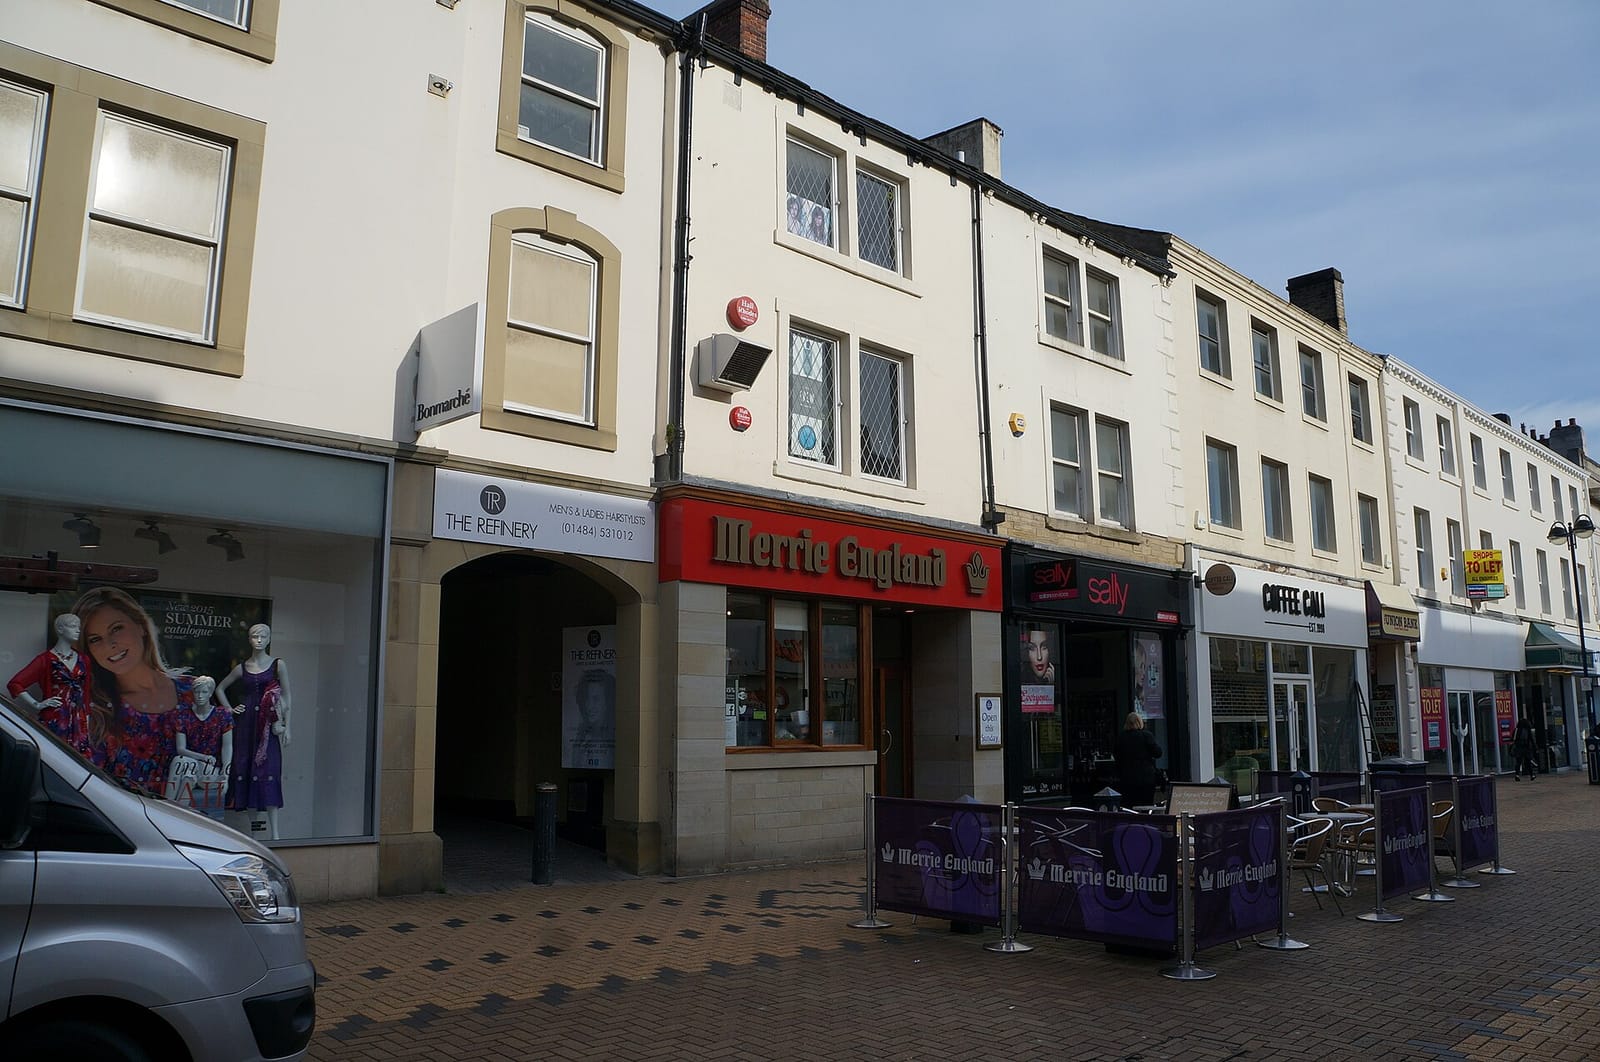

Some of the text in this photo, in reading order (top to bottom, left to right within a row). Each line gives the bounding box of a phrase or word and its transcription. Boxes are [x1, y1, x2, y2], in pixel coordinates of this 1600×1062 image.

[417, 388, 470, 421] Bonmarché
[485, 490, 501, 511] TR
[549, 504, 646, 526] MEN'S & LADIES HAIRSTYLISTS
[445, 513, 538, 540] THE REFINERY
[561, 523, 634, 541] (01484) 531012
[712, 515, 947, 589] Merrie England
[1473, 551, 1494, 559] SHOPS
[1034, 562, 1072, 587] sally
[1466, 560, 1501, 573] TO LET
[1088, 572, 1129, 615] sally
[1262, 583, 1325, 618] COFFEE CALI
[165, 611, 232, 628] SUMMER
[190, 604, 215, 616] 2015
[164, 624, 213, 638] catalogue
[1421, 699, 1442, 714] TO LET
[1503, 701, 1511, 713] LET
[982, 712, 997, 723] Open
[175, 761, 197, 775] in
[899, 848, 994, 875] Merrie England
[1050, 863, 1168, 893] Merrie England
[1216, 859, 1277, 890] Merrie England
